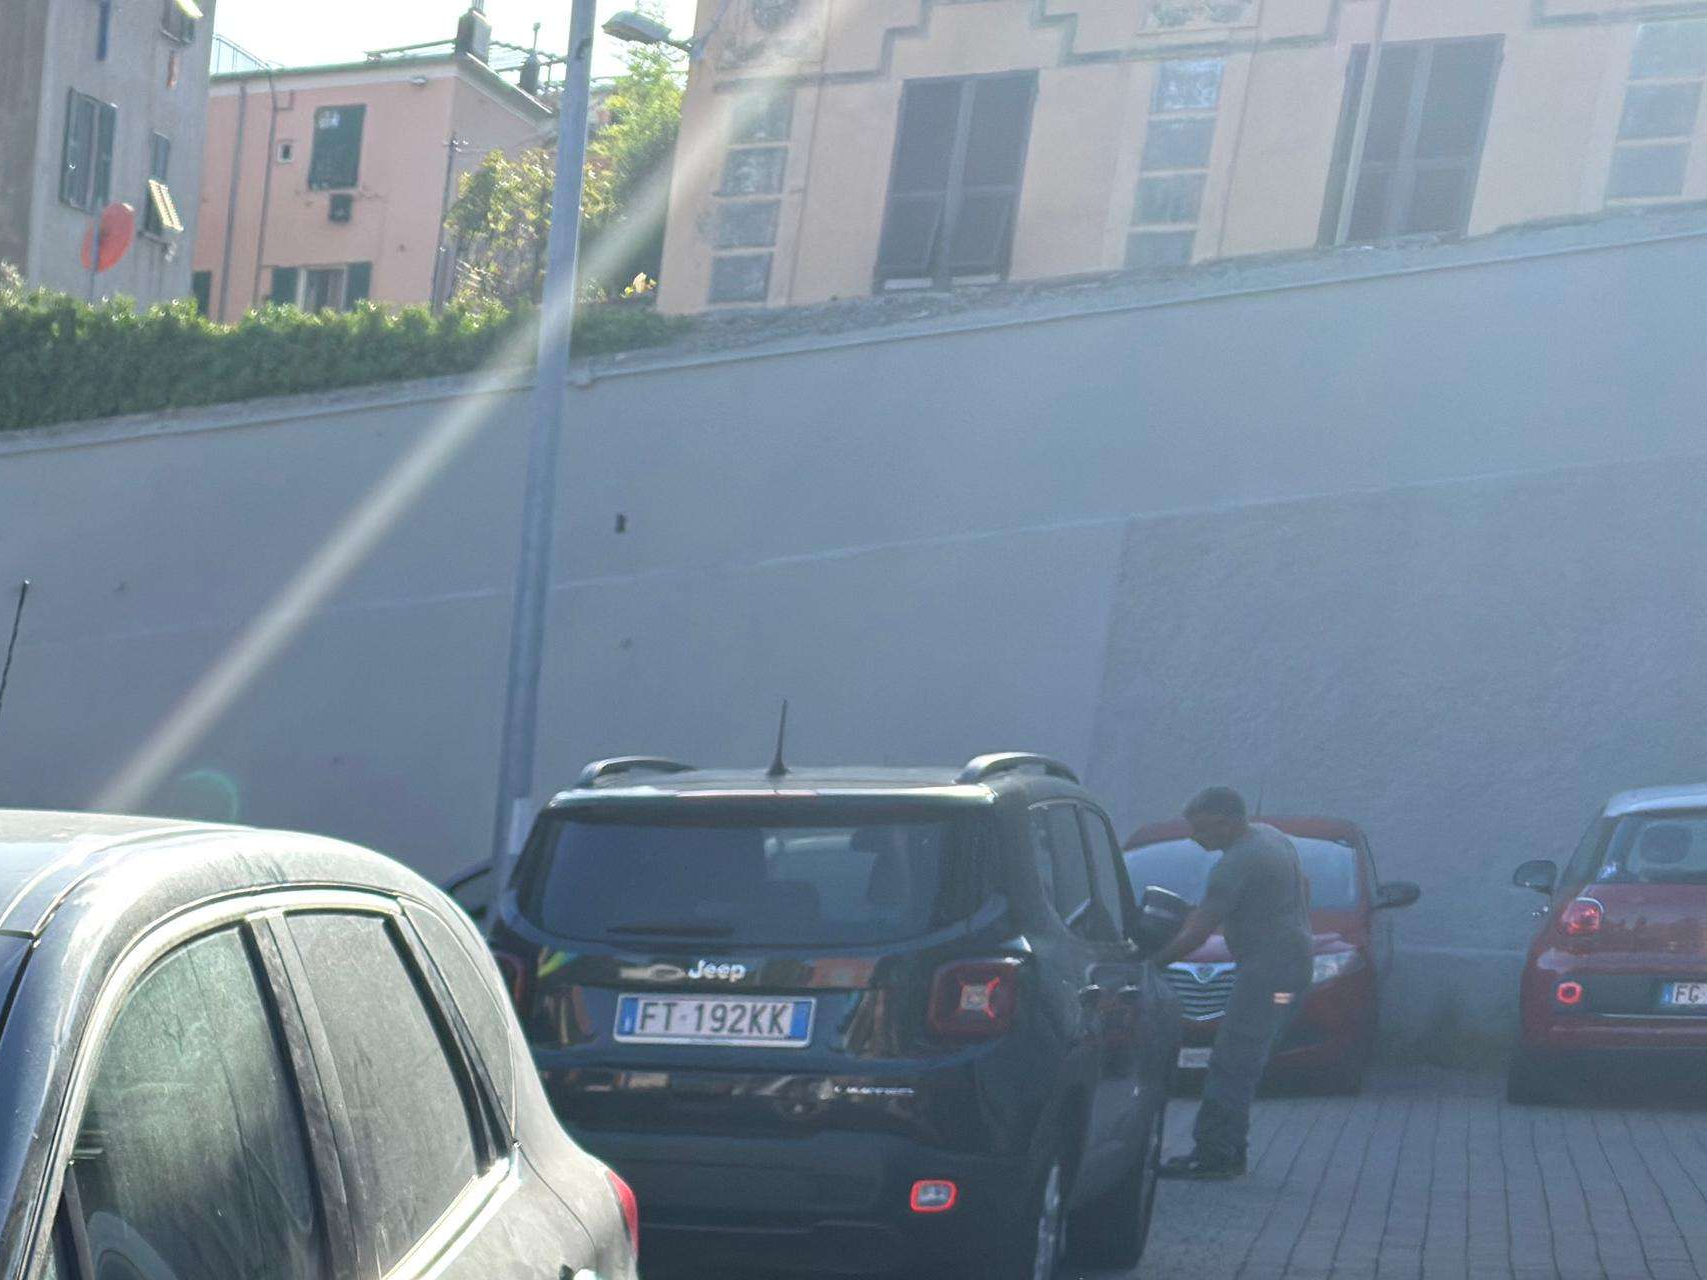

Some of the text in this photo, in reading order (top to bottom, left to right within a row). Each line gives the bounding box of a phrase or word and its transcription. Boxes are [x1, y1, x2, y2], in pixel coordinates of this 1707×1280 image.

[688, 960, 746, 983] Jeep
[638, 1002, 678, 1031] FT
[694, 1003, 788, 1035] 192KK
